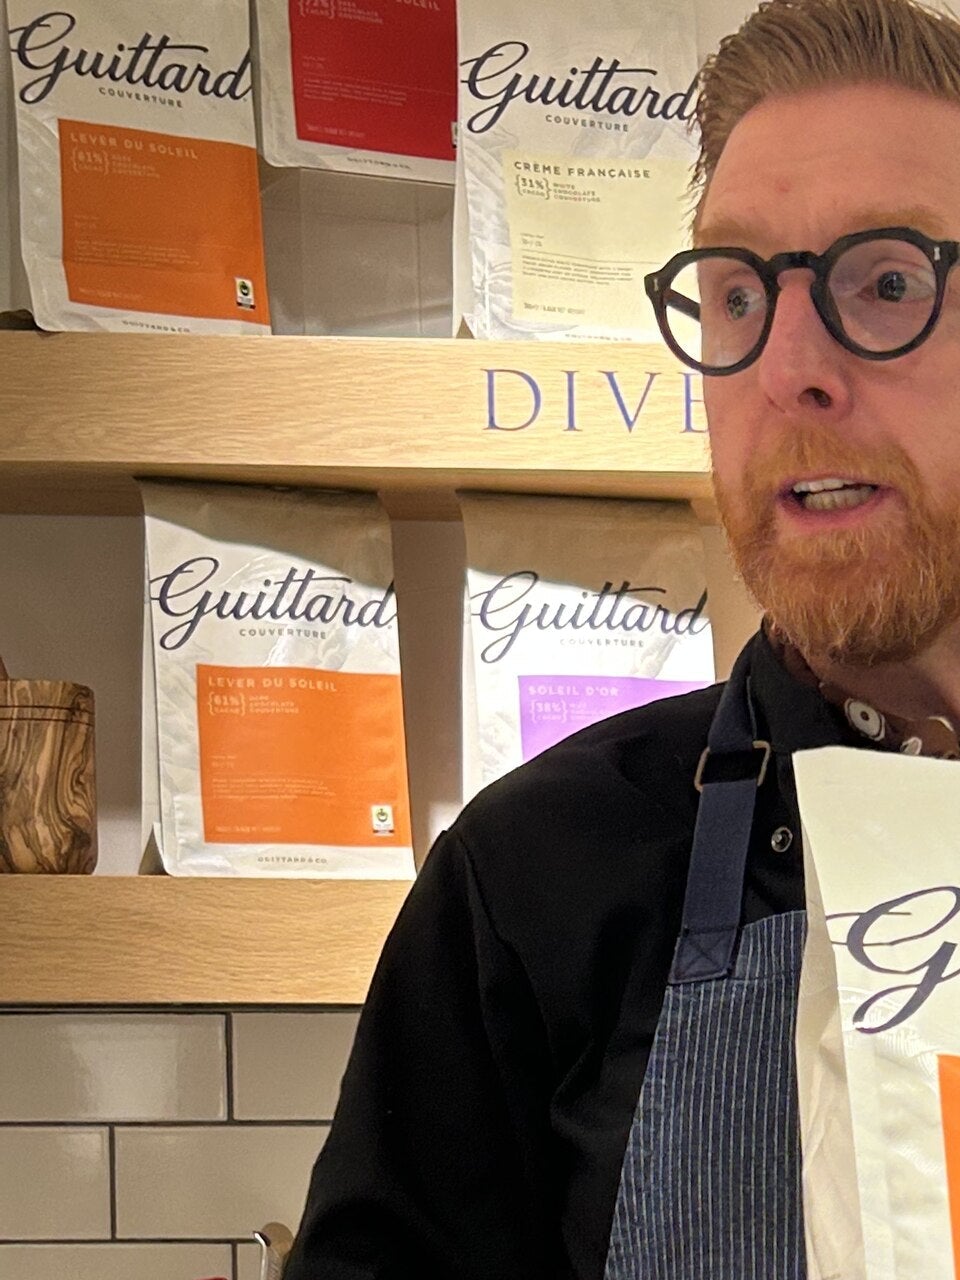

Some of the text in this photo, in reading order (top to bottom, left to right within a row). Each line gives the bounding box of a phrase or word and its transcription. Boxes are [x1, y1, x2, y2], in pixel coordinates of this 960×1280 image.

[8, 12, 251, 104] Guittard
[460, 41, 701, 133] Guittard
[98, 87, 183, 108] COUVERTURE
[545, 114, 629, 132] COUVERTURE
[70, 132, 198, 159] LEVER DU SOLEIL
[521, 178, 545, 190] 31%
[150, 557, 397, 650] Guittard
[470, 571, 710, 663] Guittard
[239, 628, 327, 640] COUVERTURE
[560, 638, 645, 648] COUVERTURE
[208, 677, 337, 692] LEVER DU SOLEIL
[529, 686, 618, 696] SOLEIL D'OR
